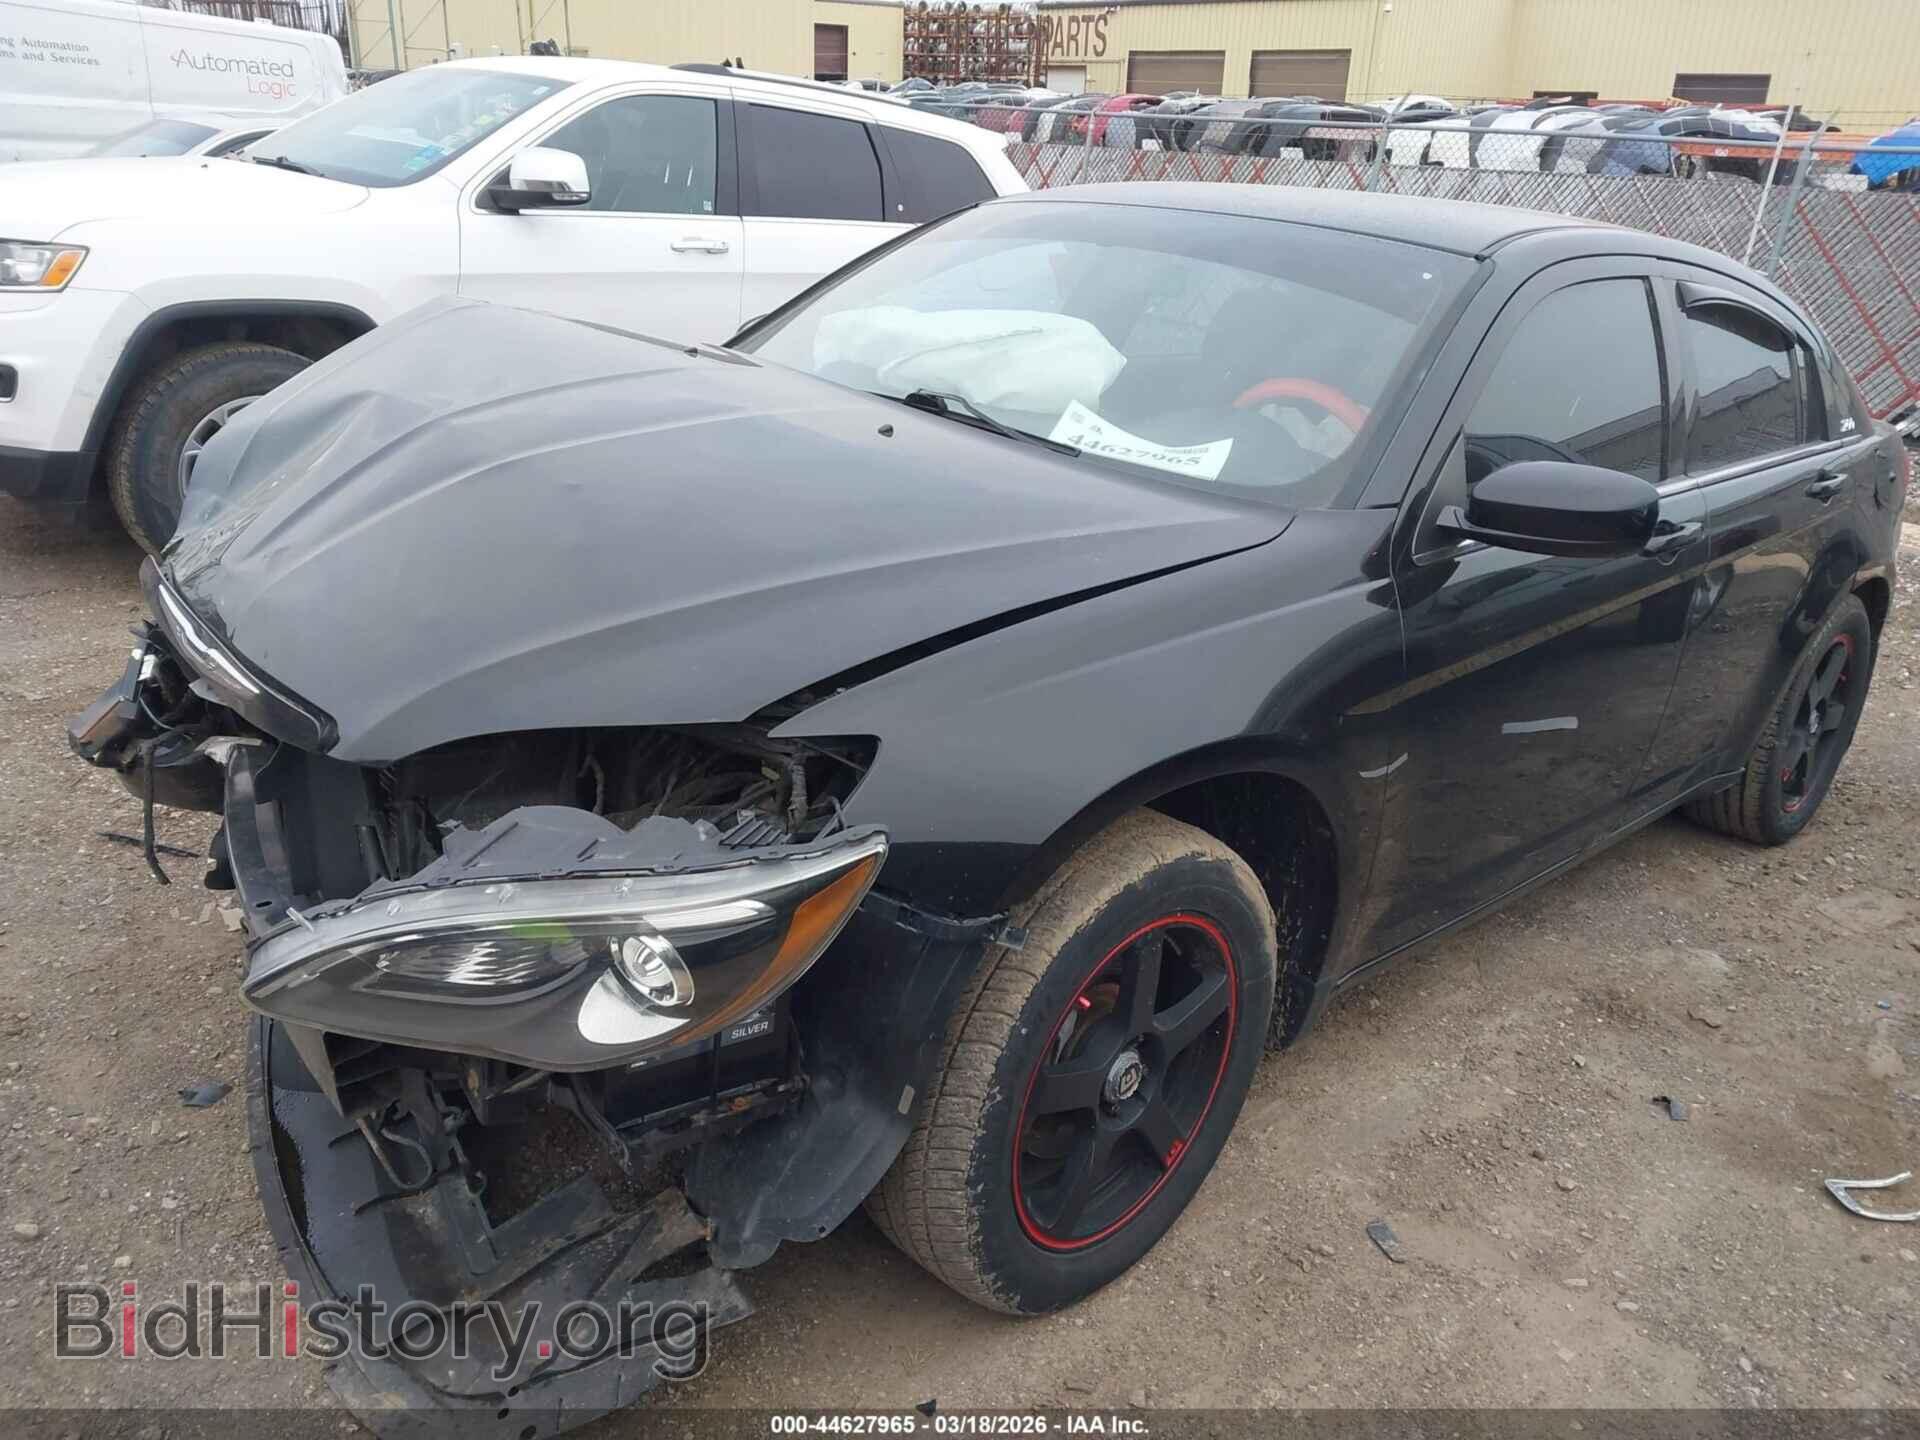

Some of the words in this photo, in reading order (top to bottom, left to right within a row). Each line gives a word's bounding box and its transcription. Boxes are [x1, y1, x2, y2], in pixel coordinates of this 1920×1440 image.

[21, 36, 89, 52] Automation
[22, 52, 44, 61] and
[49, 52, 100, 66] Services
[170, 48, 294, 78] Automated
[246, 75, 296, 99] Logic
[730, 1021, 769, 1040] SILVER
